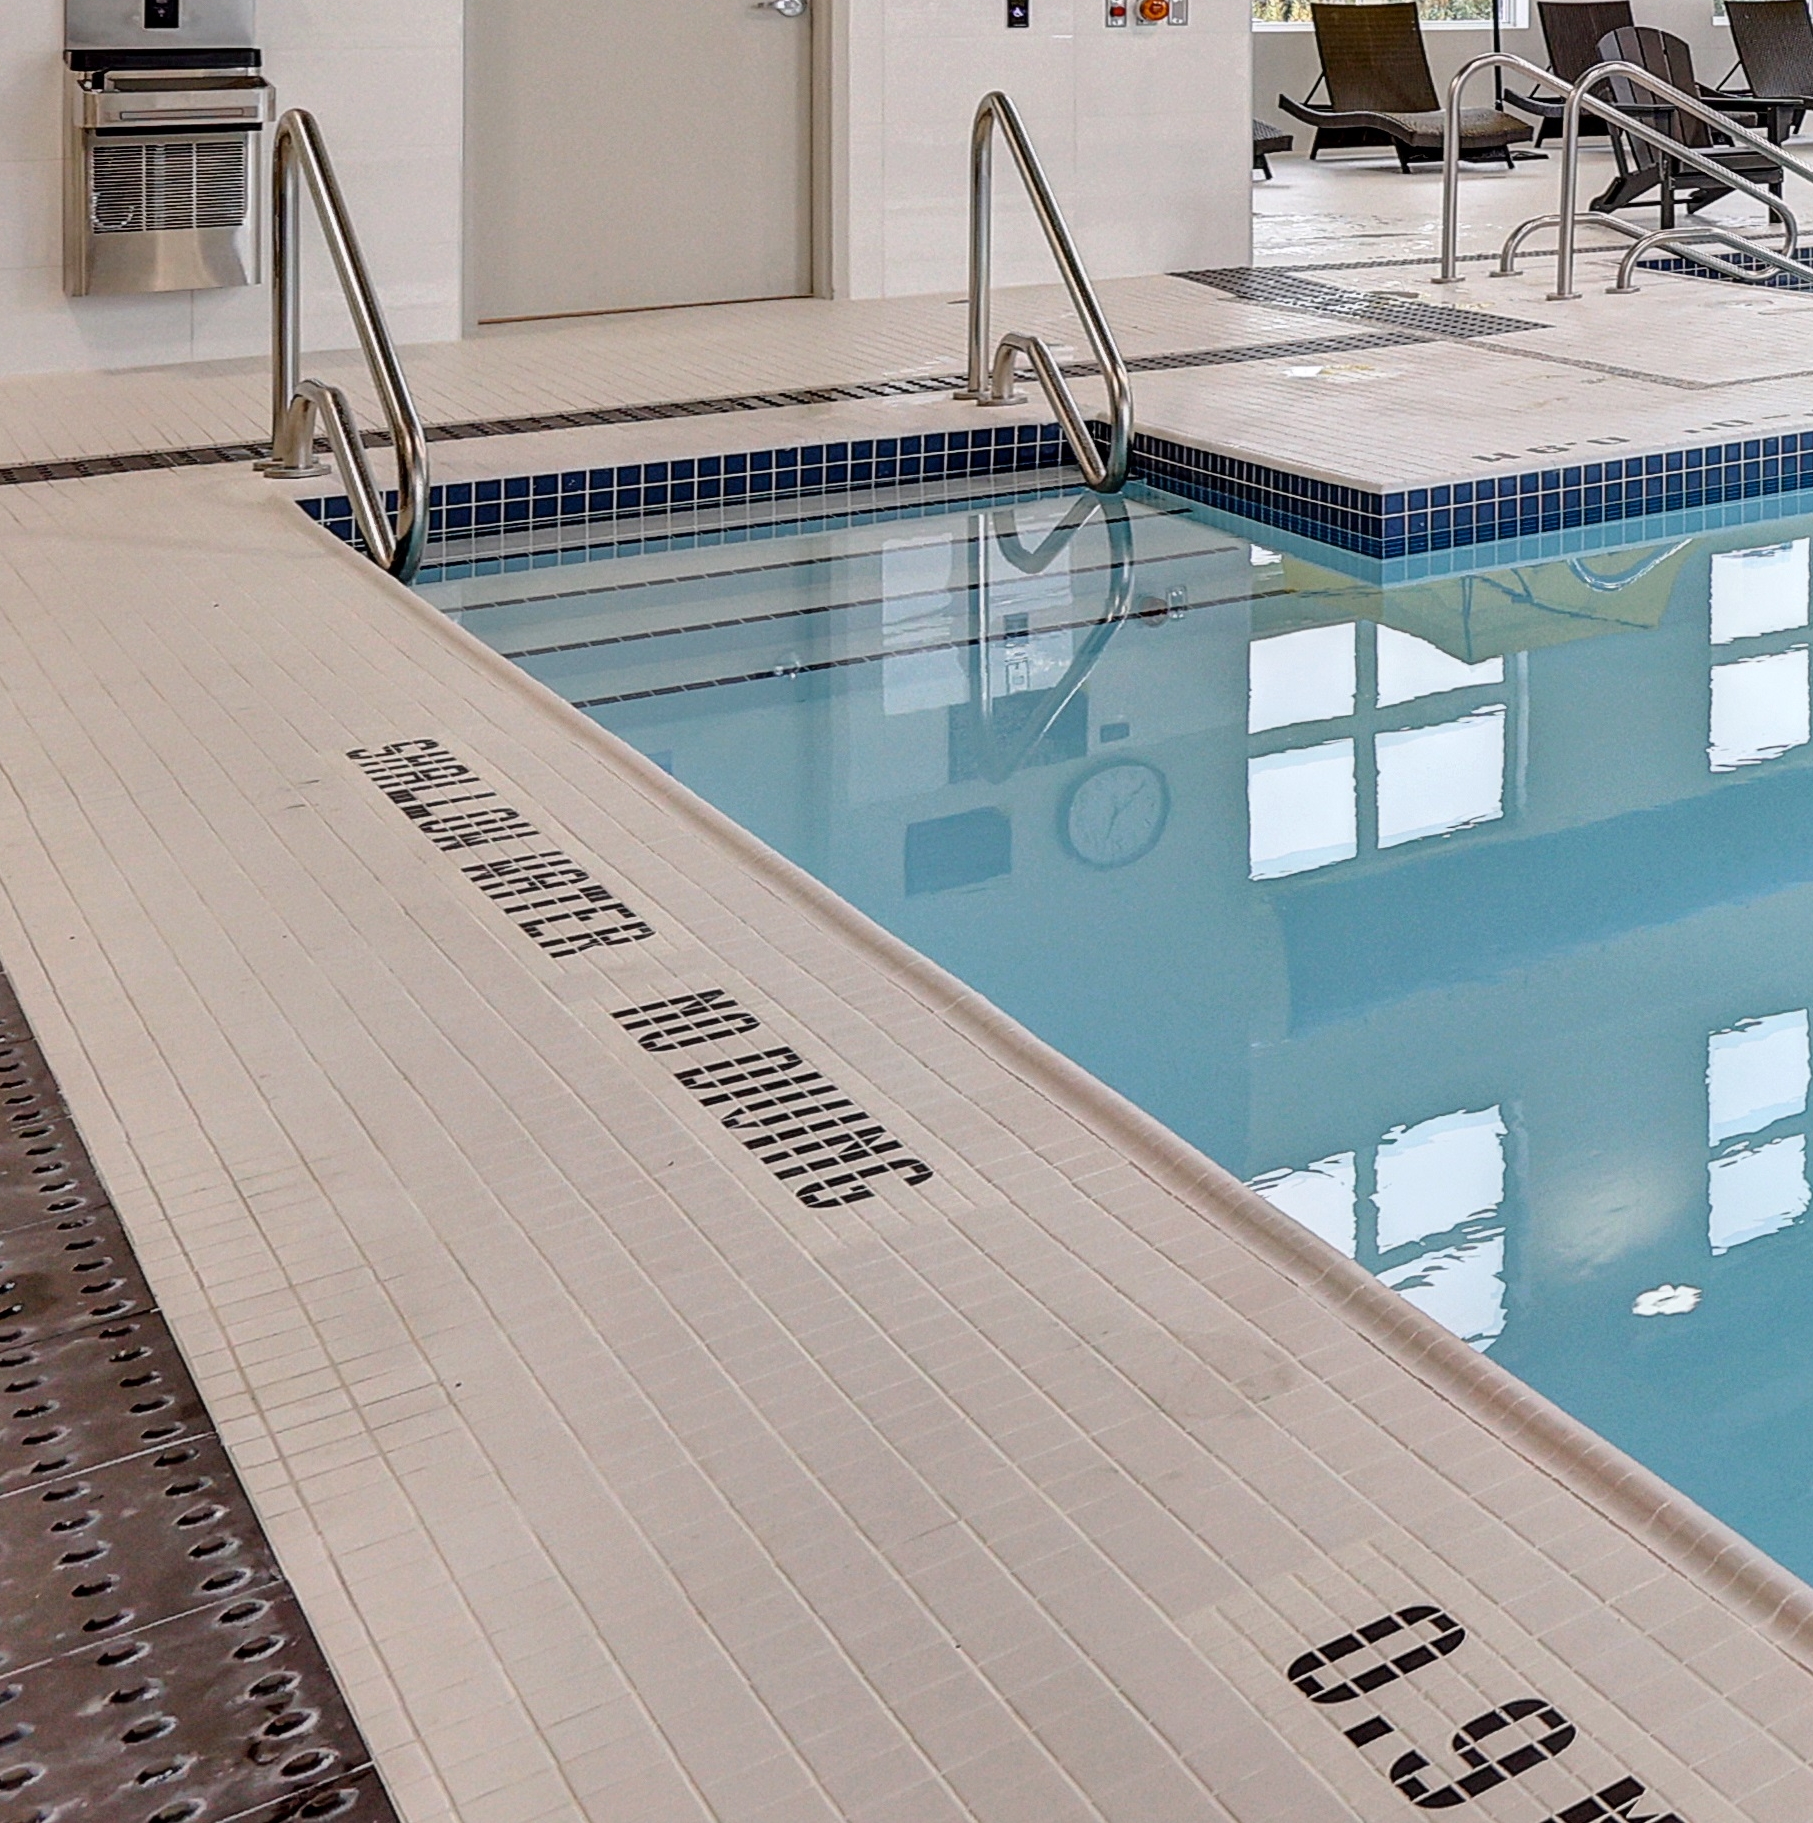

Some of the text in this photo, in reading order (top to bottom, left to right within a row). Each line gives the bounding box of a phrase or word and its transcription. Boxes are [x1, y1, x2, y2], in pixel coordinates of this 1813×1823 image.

[345, 737, 657, 959] SHALLOW WATER
[610, 987, 934, 1209] NO DIVING
